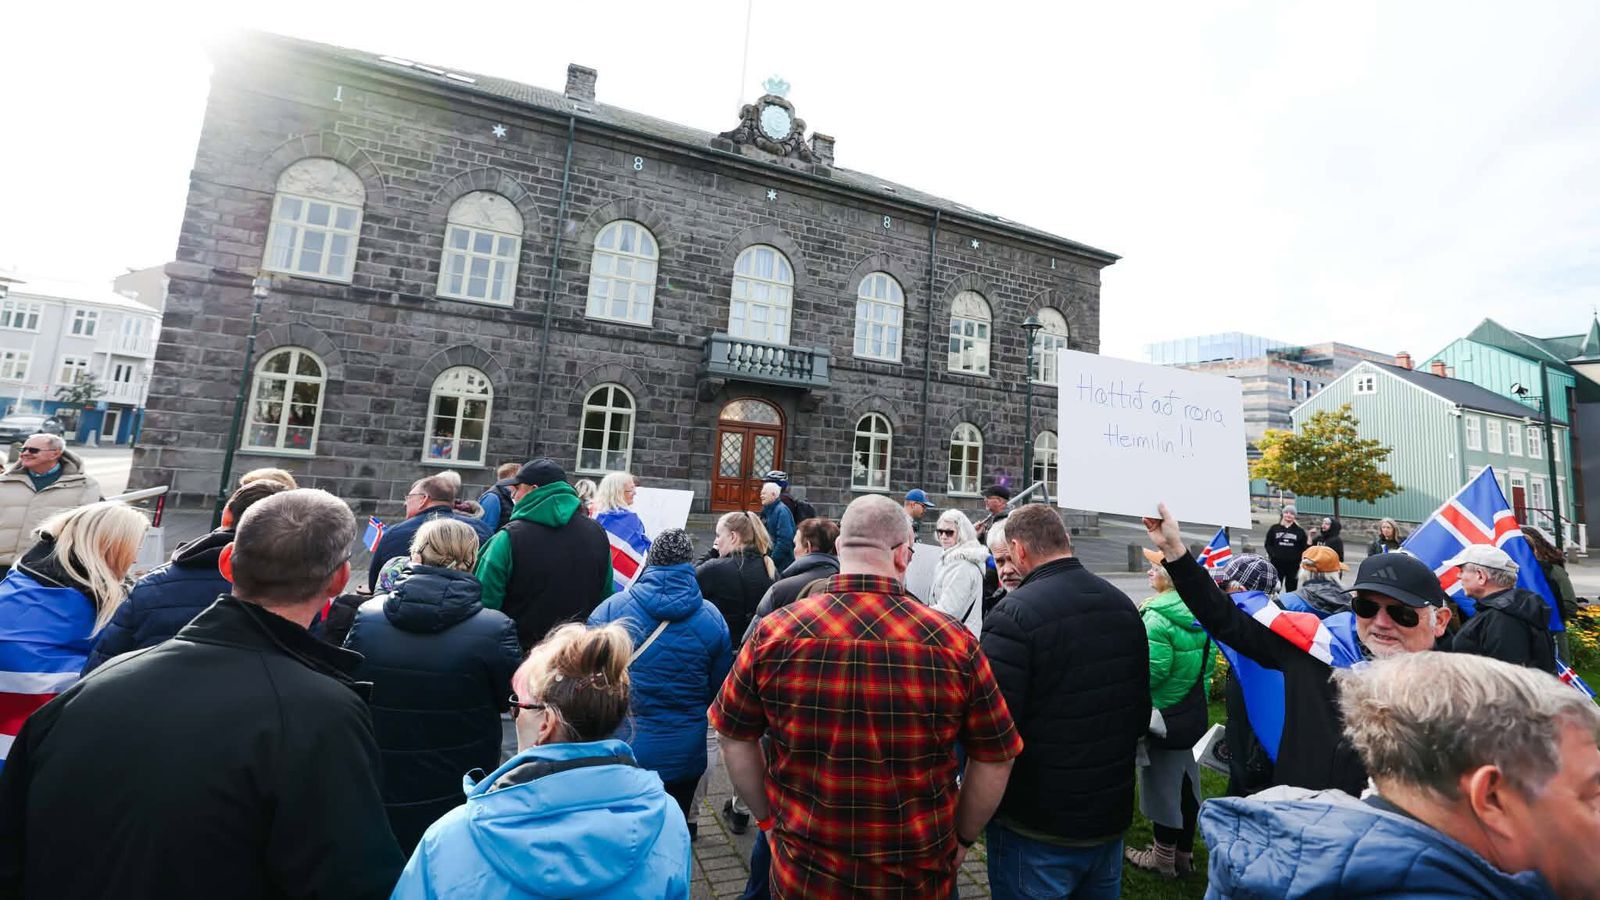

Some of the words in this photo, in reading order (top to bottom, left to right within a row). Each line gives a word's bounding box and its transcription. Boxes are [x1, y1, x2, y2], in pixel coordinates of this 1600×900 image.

[333, 86, 343, 102] 1
[633, 156, 643, 171] 8
[883, 215, 891, 229] 8
[1152, 389, 1182, 416] að
